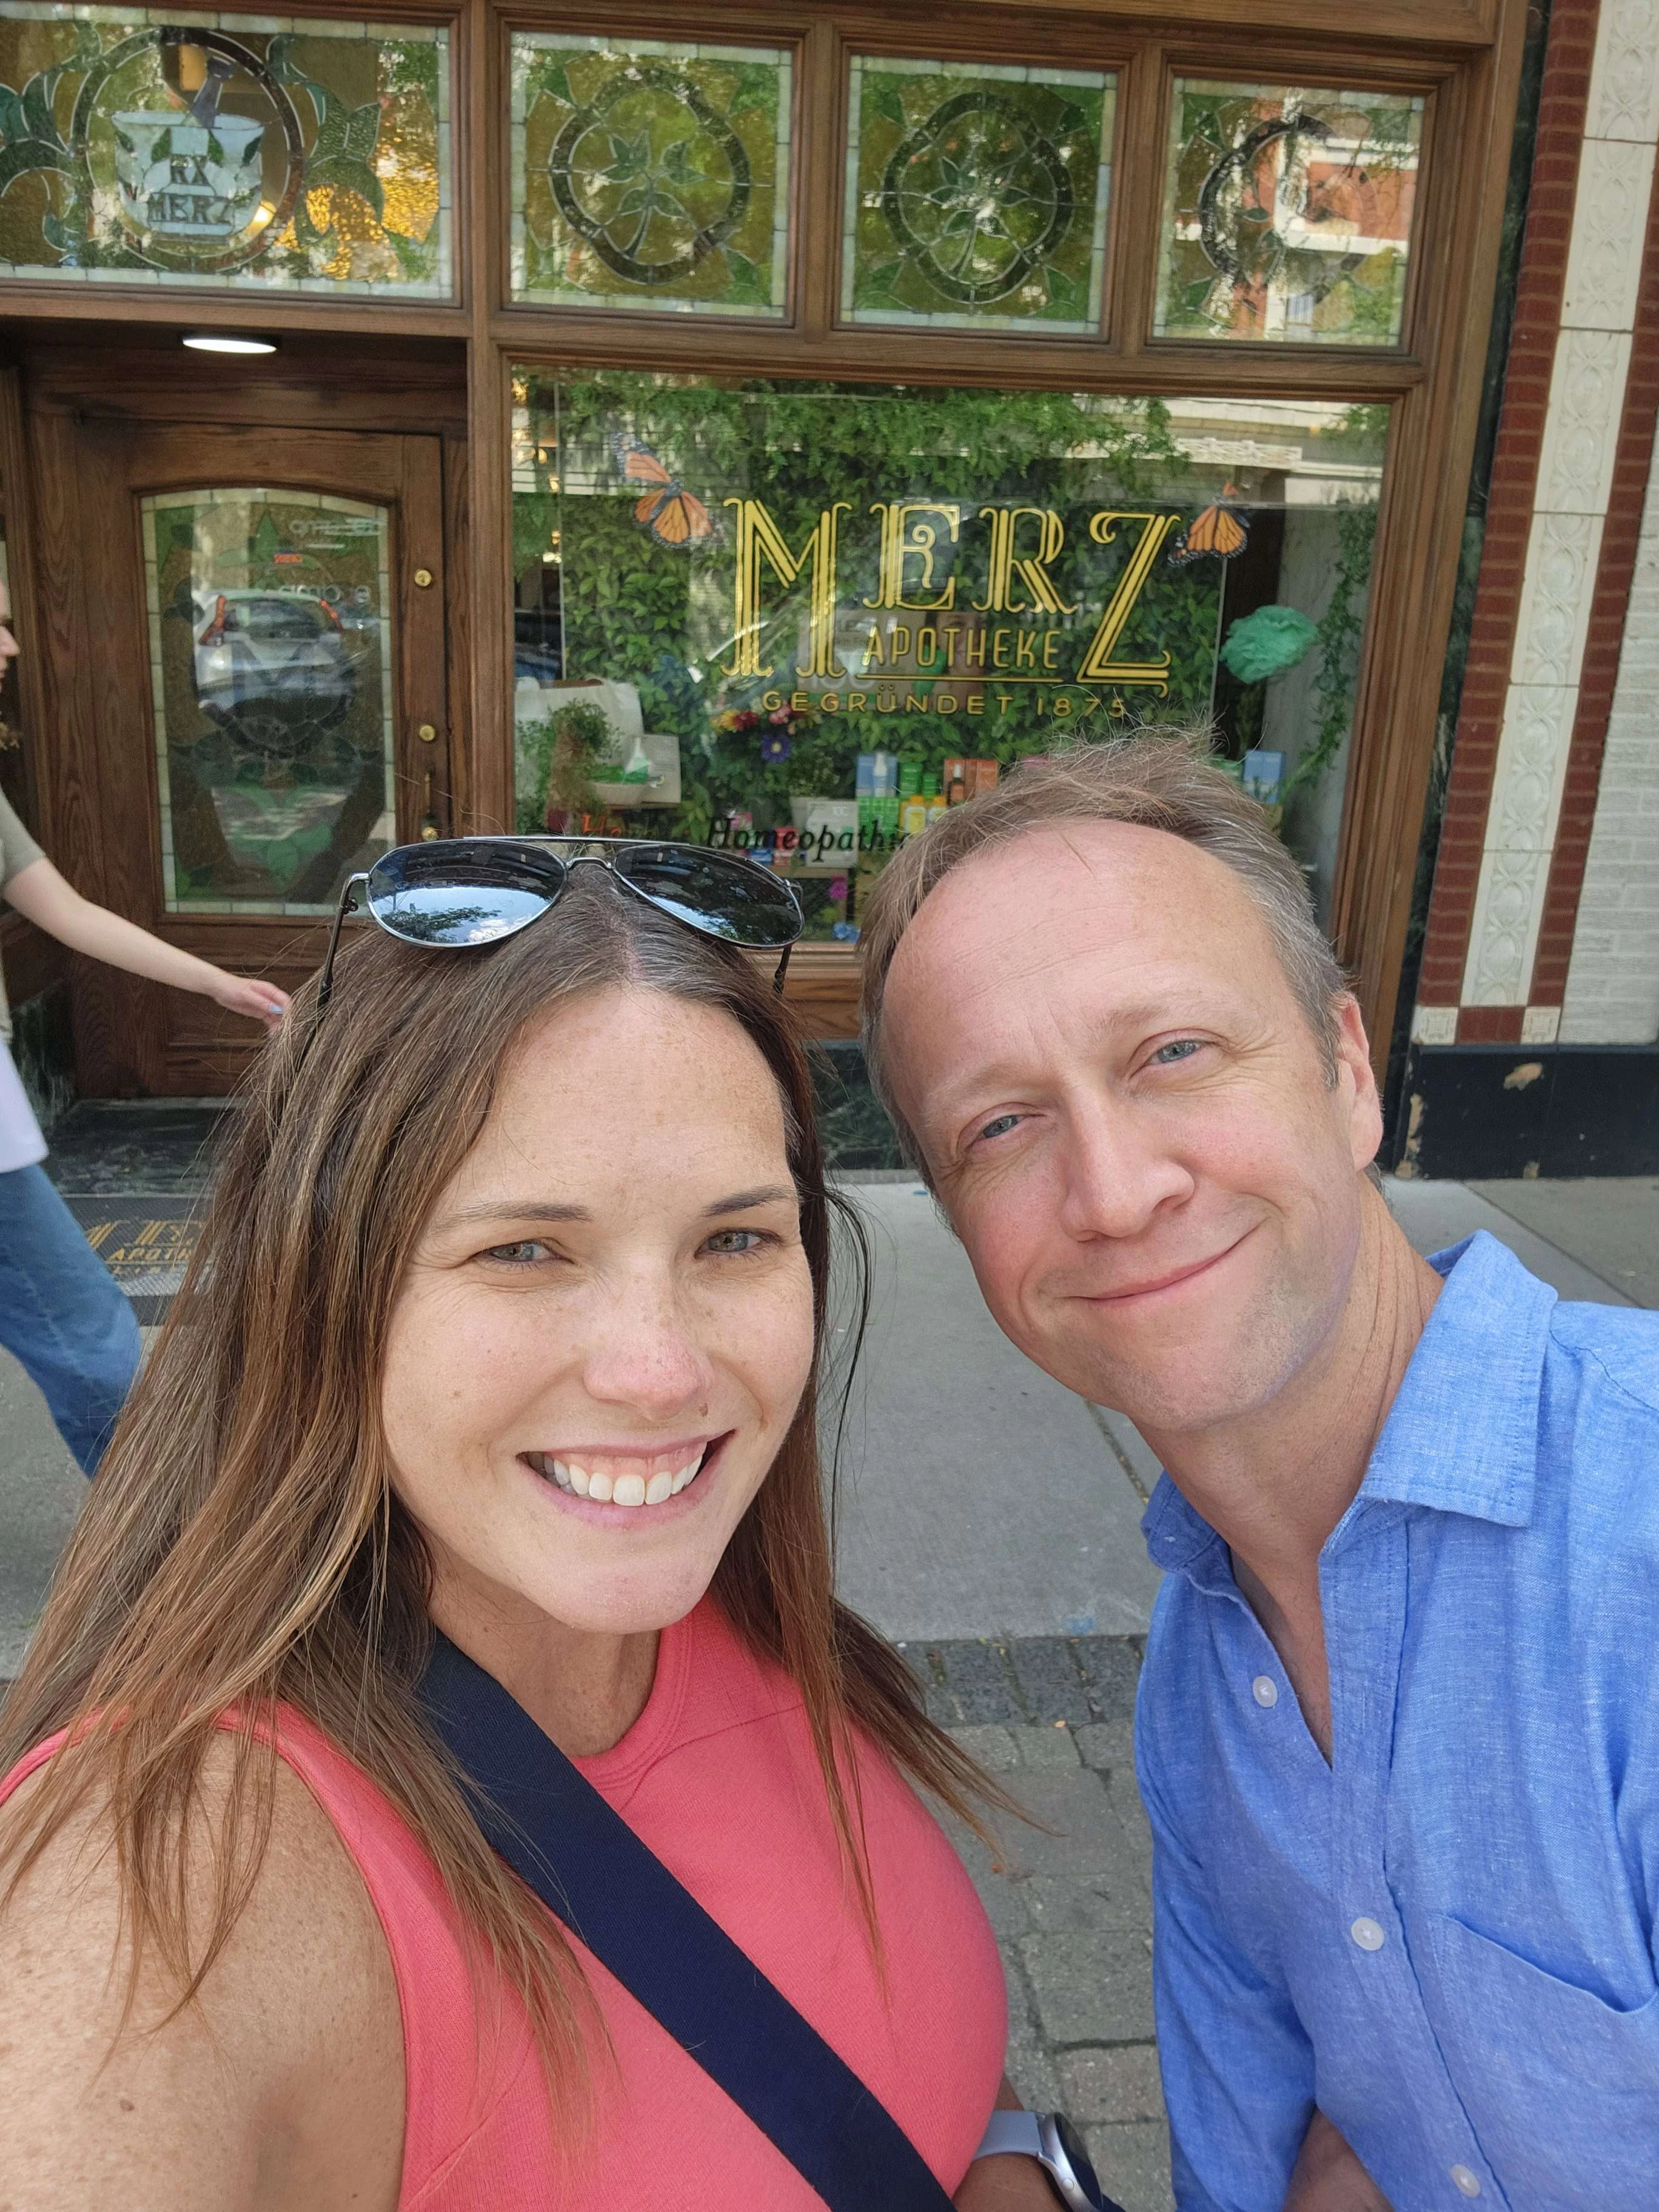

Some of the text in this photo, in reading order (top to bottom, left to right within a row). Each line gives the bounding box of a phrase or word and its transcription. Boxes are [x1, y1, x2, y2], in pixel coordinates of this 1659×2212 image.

[719, 497, 1181, 699] MERZ
[862, 626, 1061, 670] APOTHEKE
[762, 684, 1126, 719] GEGRÜNDET 1875
